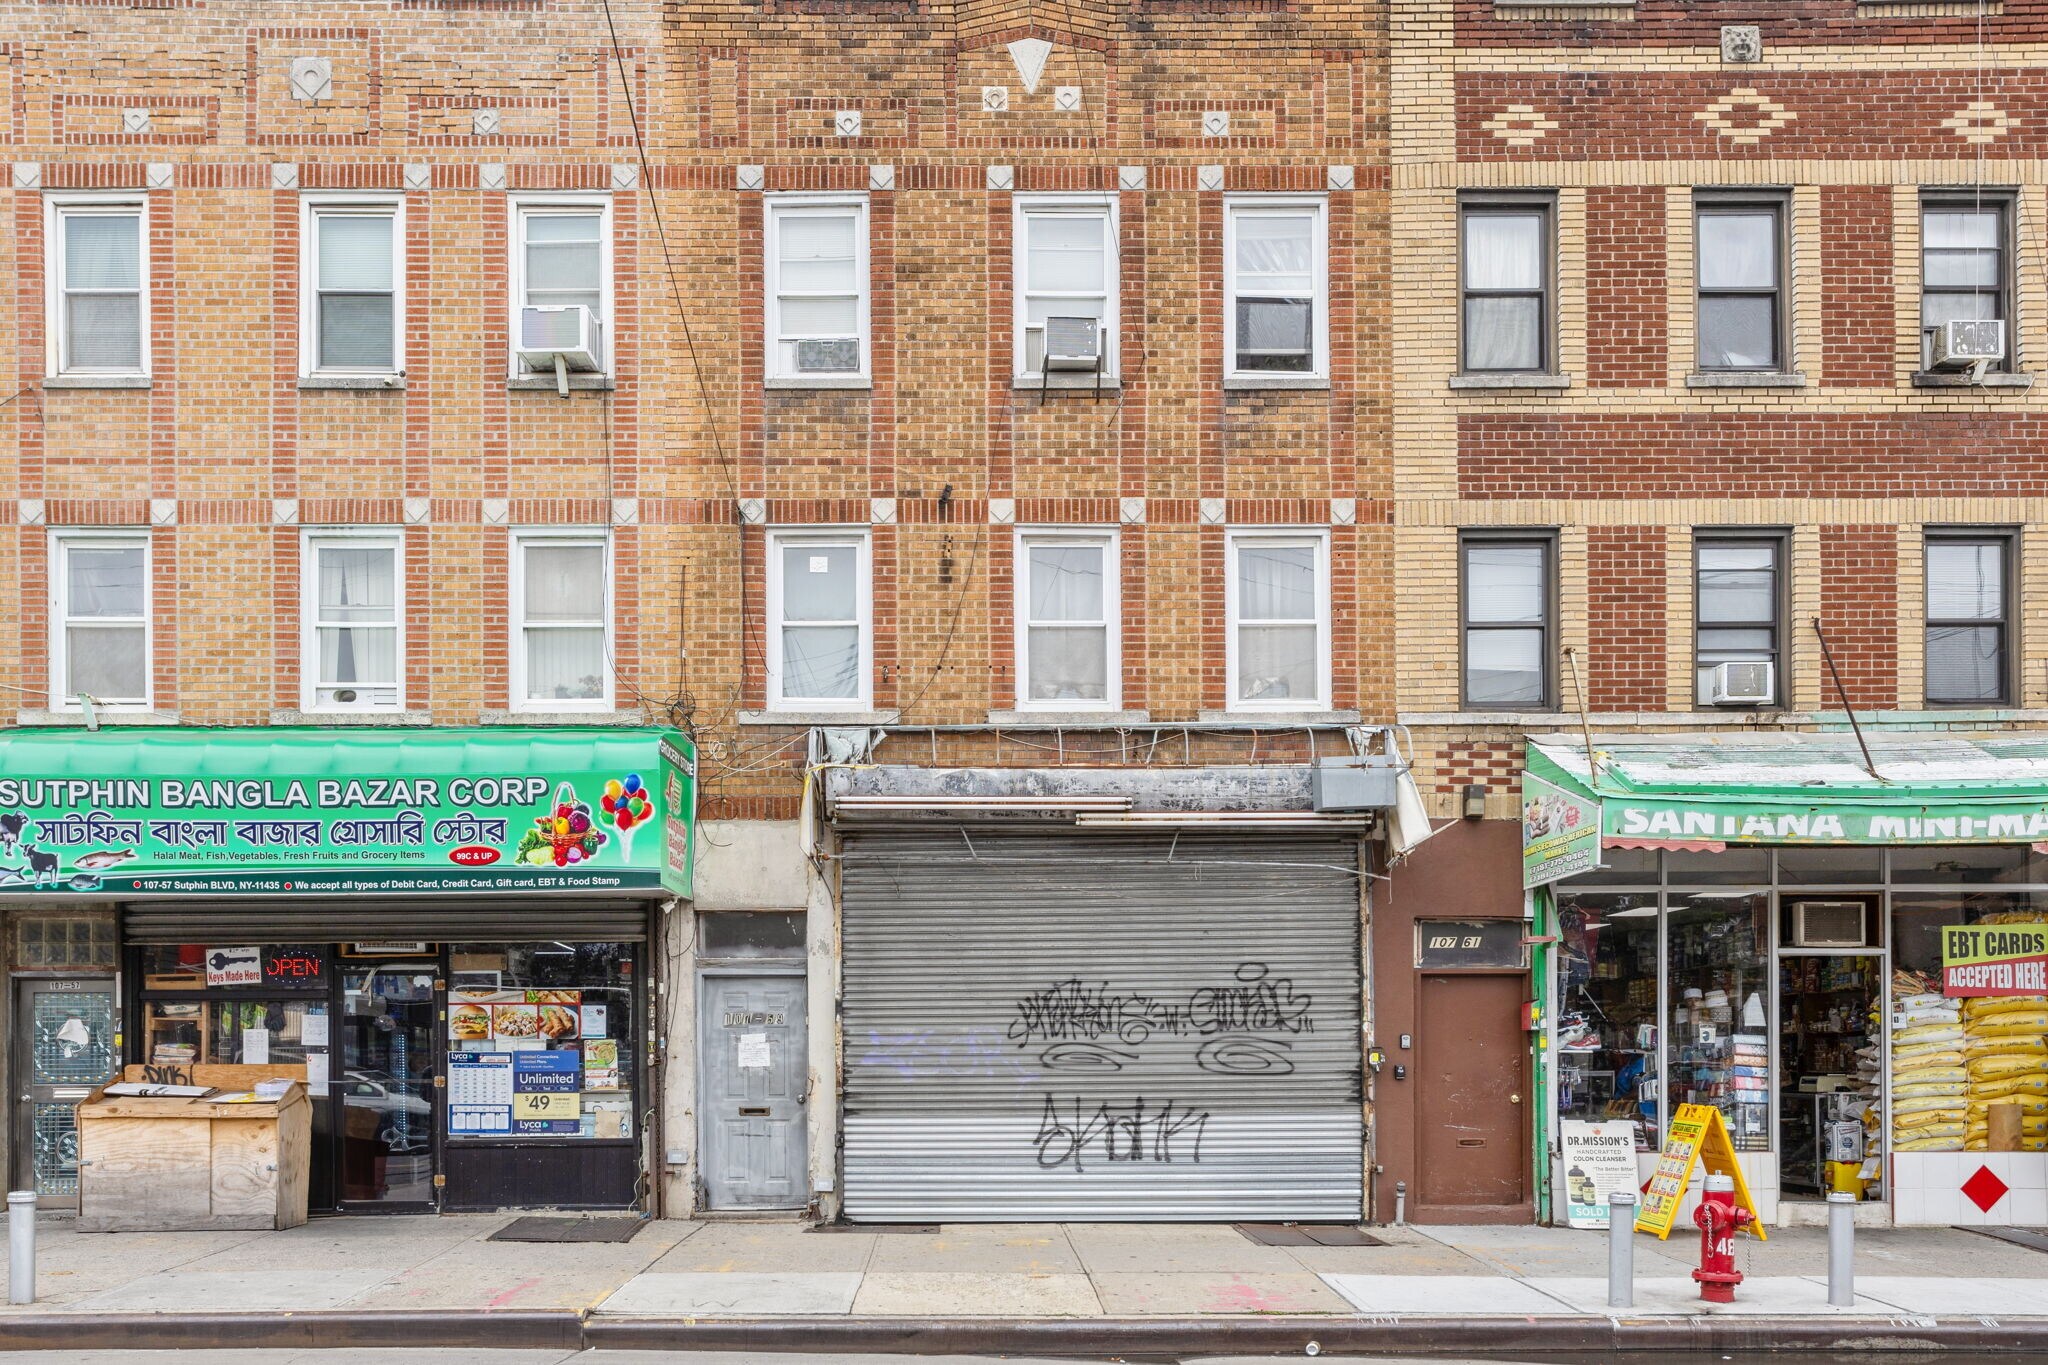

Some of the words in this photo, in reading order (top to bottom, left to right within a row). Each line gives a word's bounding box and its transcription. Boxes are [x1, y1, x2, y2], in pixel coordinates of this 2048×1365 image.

[680, 756, 694, 776] STORE
[0, 780, 150, 807] SUTPHIN
[161, 780, 312, 807] BANGLA
[318, 779, 440, 807] BAZAR
[448, 778, 549, 806] CORP
[36, 811, 142, 844] সাটফিন
[150, 820, 228, 848] বাংলা
[235, 820, 322, 846] বাজার
[330, 811, 425, 846] গ্রোসারি
[434, 813, 507, 845] স্টোর
[1568, 824, 1596, 842] AFRICAN
[153, 852, 176, 860] Halal
[180, 851, 204, 861] Meat,
[283, 851, 310, 860] Fresh
[312, 851, 339, 859] Fruits
[341, 851, 359, 859] and
[361, 851, 398, 861] Grocery
[400, 850, 425, 859] Items
[456, 852, 472, 860] 99C
[473, 852, 480, 860] &
[481, 852, 493, 860] UP
[1545, 844, 1570, 860] MARKET
[143, 881, 172, 889] 107-57
[174, 881, 209, 891] Sutphin
[210, 881, 238, 890] BLVD,
[239, 881, 280, 890] NY-11435
[294, 881, 309, 889] We
[310, 881, 341, 891] accept
[342, 881, 353, 889] all
[354, 881, 379, 891] types
[380, 880, 390, 889] of
[391, 880, 415, 889] Debit
[416, 880, 440, 889] Card,
[442, 879, 469, 888] Credit
[470, 879, 495, 888] Card,
[496, 878, 513, 887] Gift
[514, 878, 536, 888] card,
[538, 878, 557, 886] EBT
[558, 878, 566, 886] &
[567, 877, 590, 886] Food
[592, 877, 620, 887] Stamp
[1432, 937, 1457, 948] 107
[1463, 937, 1479, 948] 61
[1948, 931, 1980, 959] EBT
[1985, 931, 2045, 956] CARDS
[266, 959, 320, 976] OPEN
[208, 971, 224, 984] Keys
[225, 970, 243, 982] Made
[244, 969, 260, 981] Here
[1948, 964, 2013, 989] ACCEPTED
[2015, 961, 2047, 990] HERE
[519, 1073, 574, 1084] Unlimited
[519, 1120, 541, 1130] Lyca
[1567, 1136, 1629, 1146] DR.MISSION'S
[1575, 1207, 1604, 1217] SOLD
